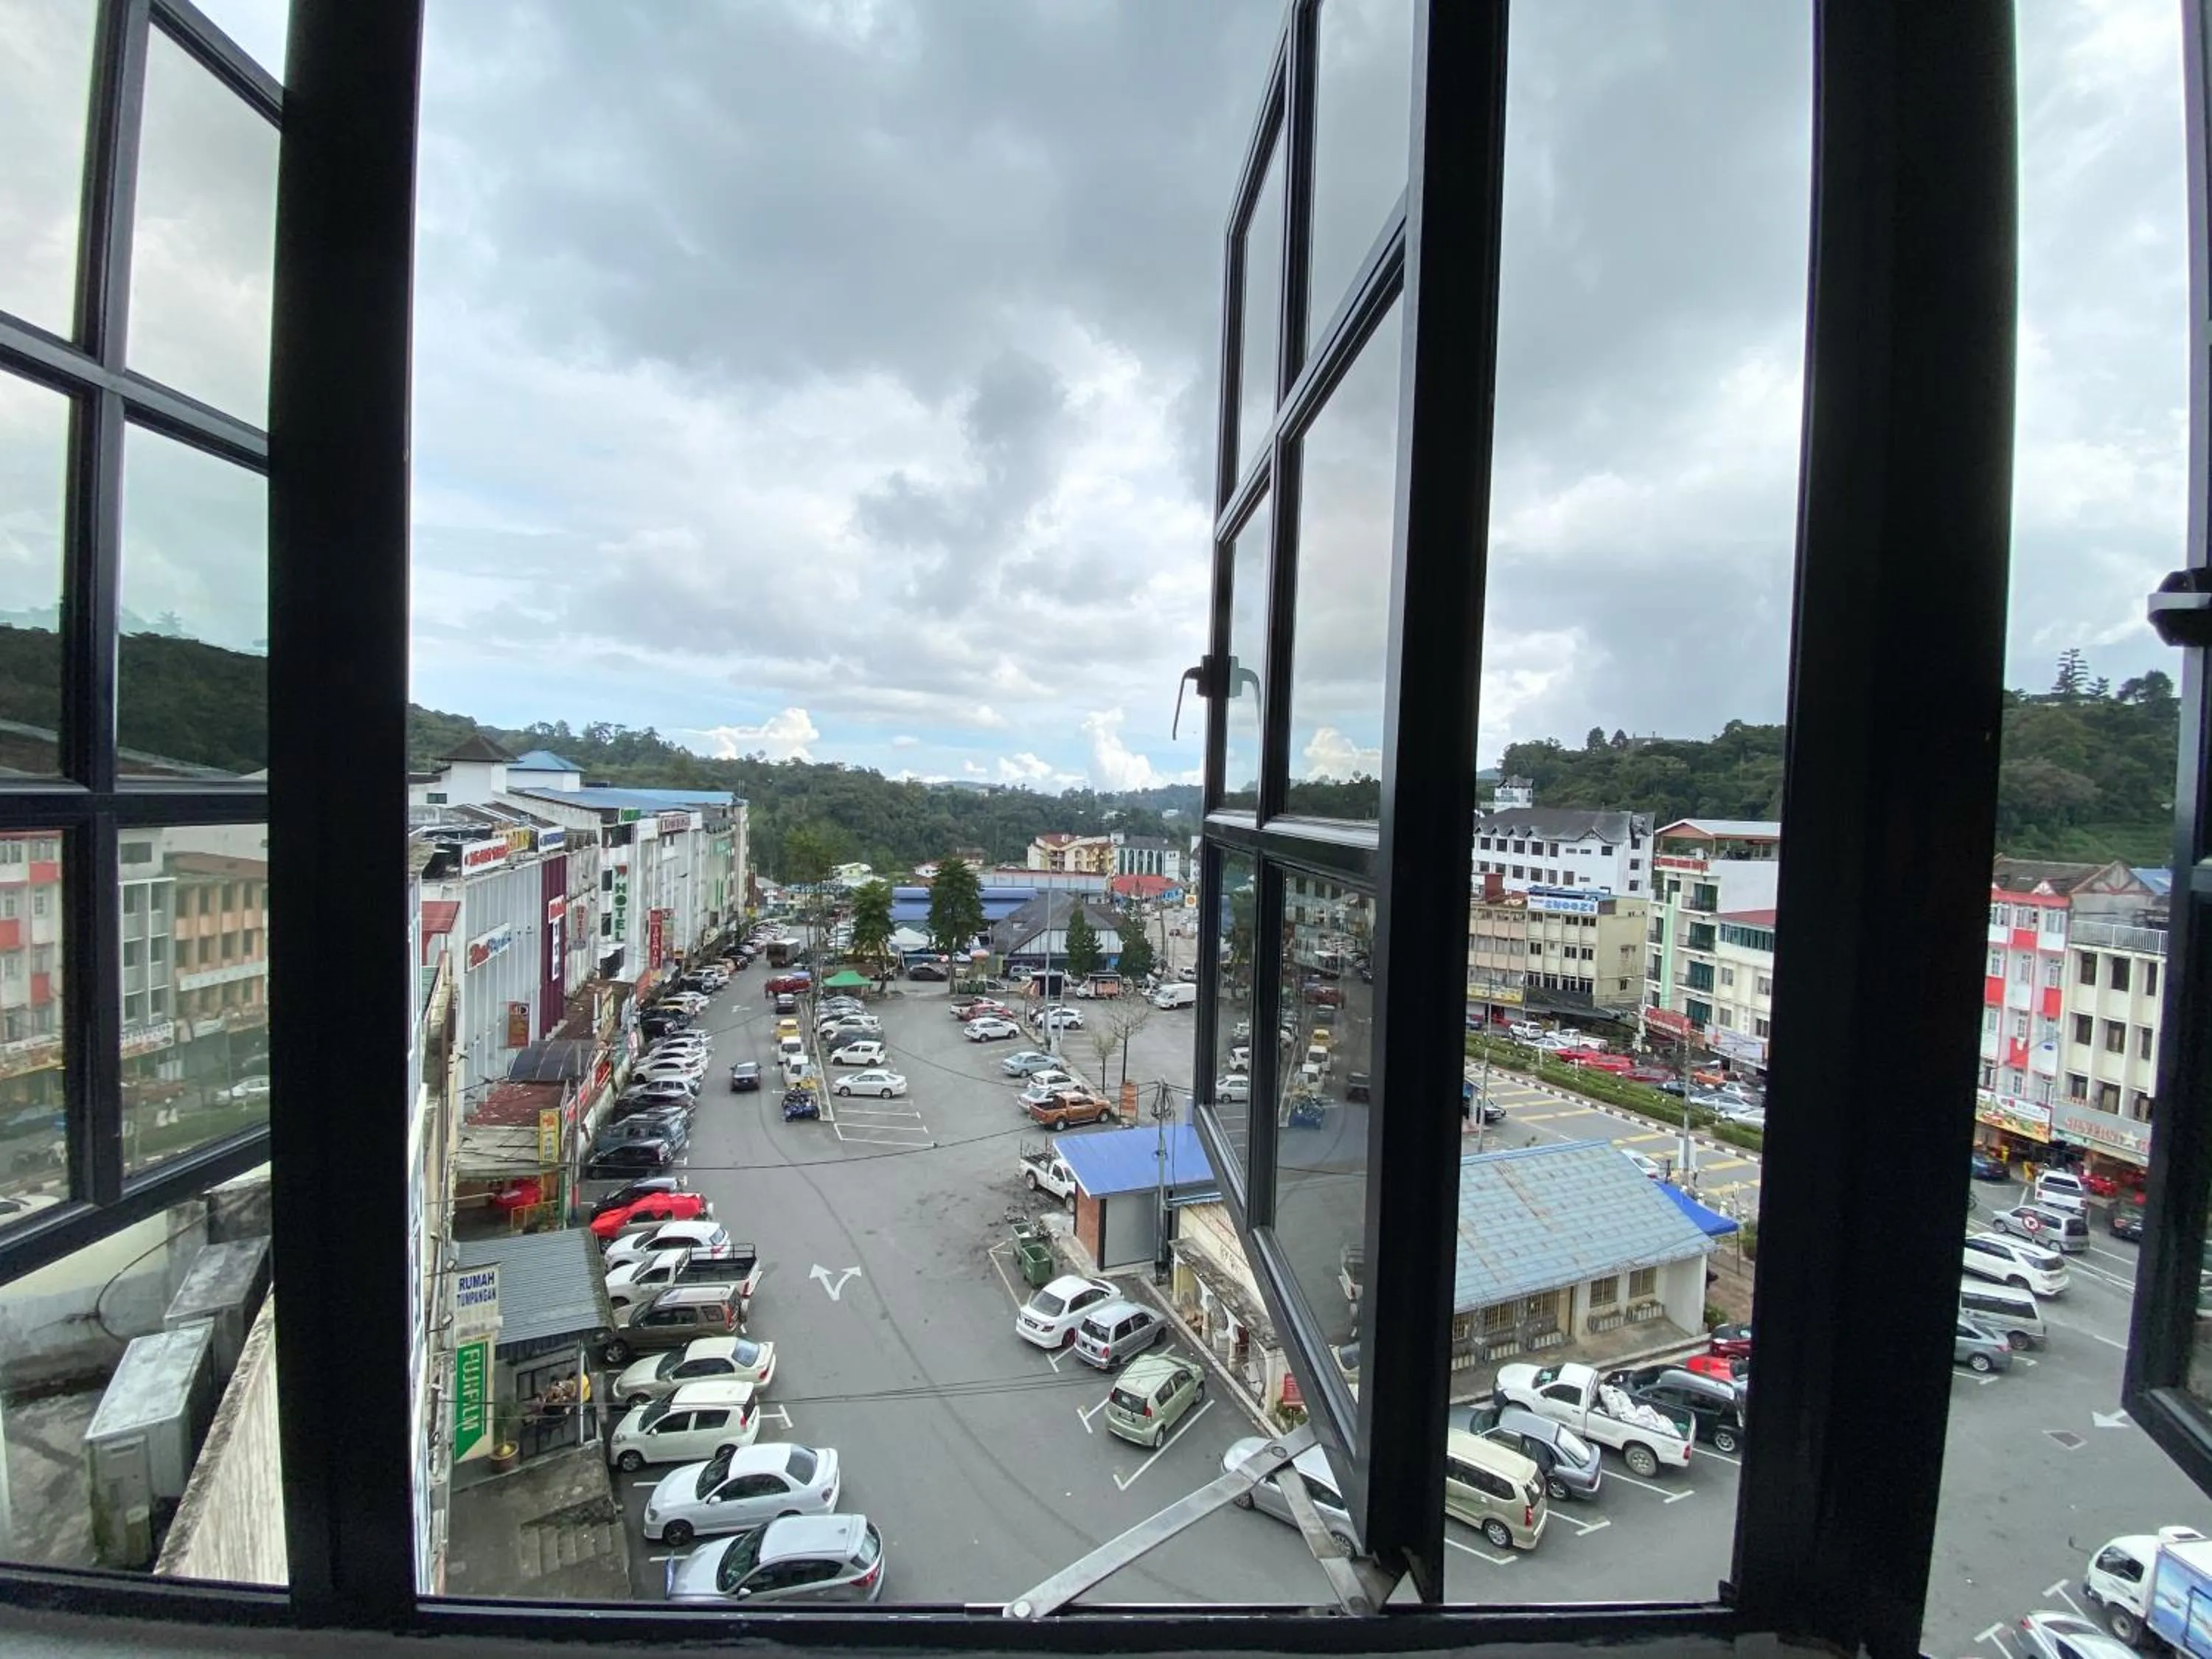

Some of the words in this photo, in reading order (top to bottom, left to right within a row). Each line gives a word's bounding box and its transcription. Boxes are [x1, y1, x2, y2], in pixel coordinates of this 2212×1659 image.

[615, 883, 627, 942] HOTEL
[457, 1288, 496, 1307] TUMPANGAN
[459, 1271, 495, 1291] RUMAH
[462, 1349, 480, 1431] FUJIFILM
